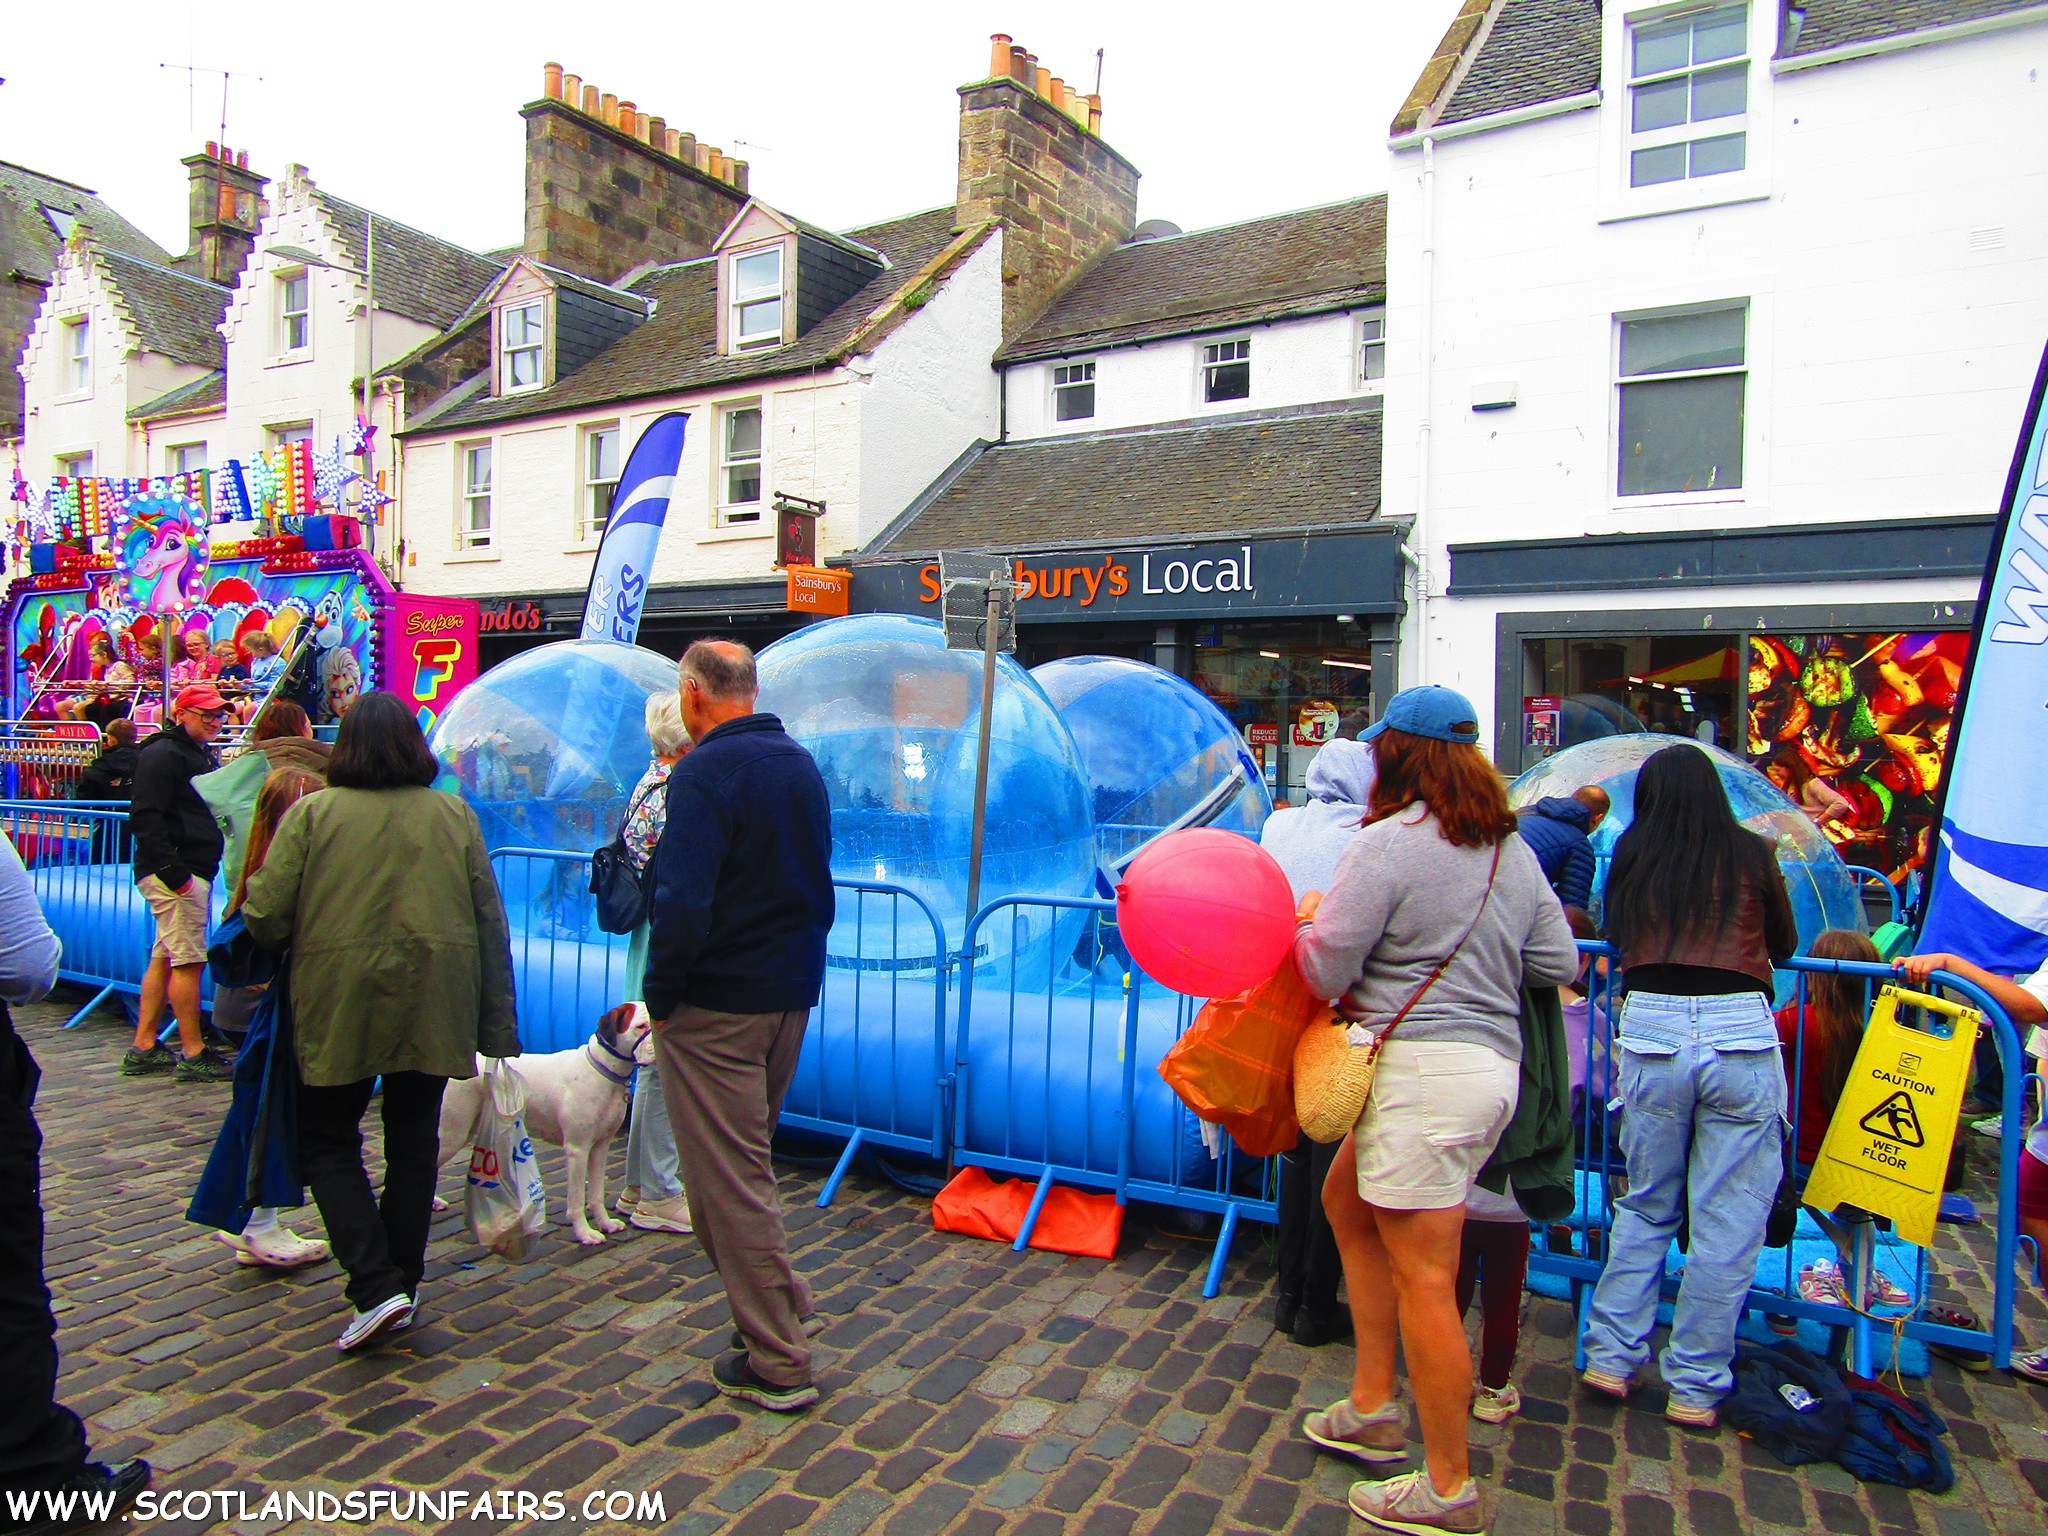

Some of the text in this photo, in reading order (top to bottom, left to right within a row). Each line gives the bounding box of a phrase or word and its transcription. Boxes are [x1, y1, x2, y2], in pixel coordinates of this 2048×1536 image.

[795, 575, 841, 593] Sainsbury's
[919, 546, 1254, 607] Sbury's Local
[583, 575, 613, 639] ER
[612, 564, 644, 643] ERS
[795, 591, 816, 603] Local
[406, 611, 464, 636] Super
[480, 601, 541, 631] ndo's
[60, 727, 87, 737] WAY IN
[1871, 1068, 1936, 1096] CAUTION
[1862, 1147, 1907, 1171] FLOOR
[1872, 1139, 1901, 1156] WET
